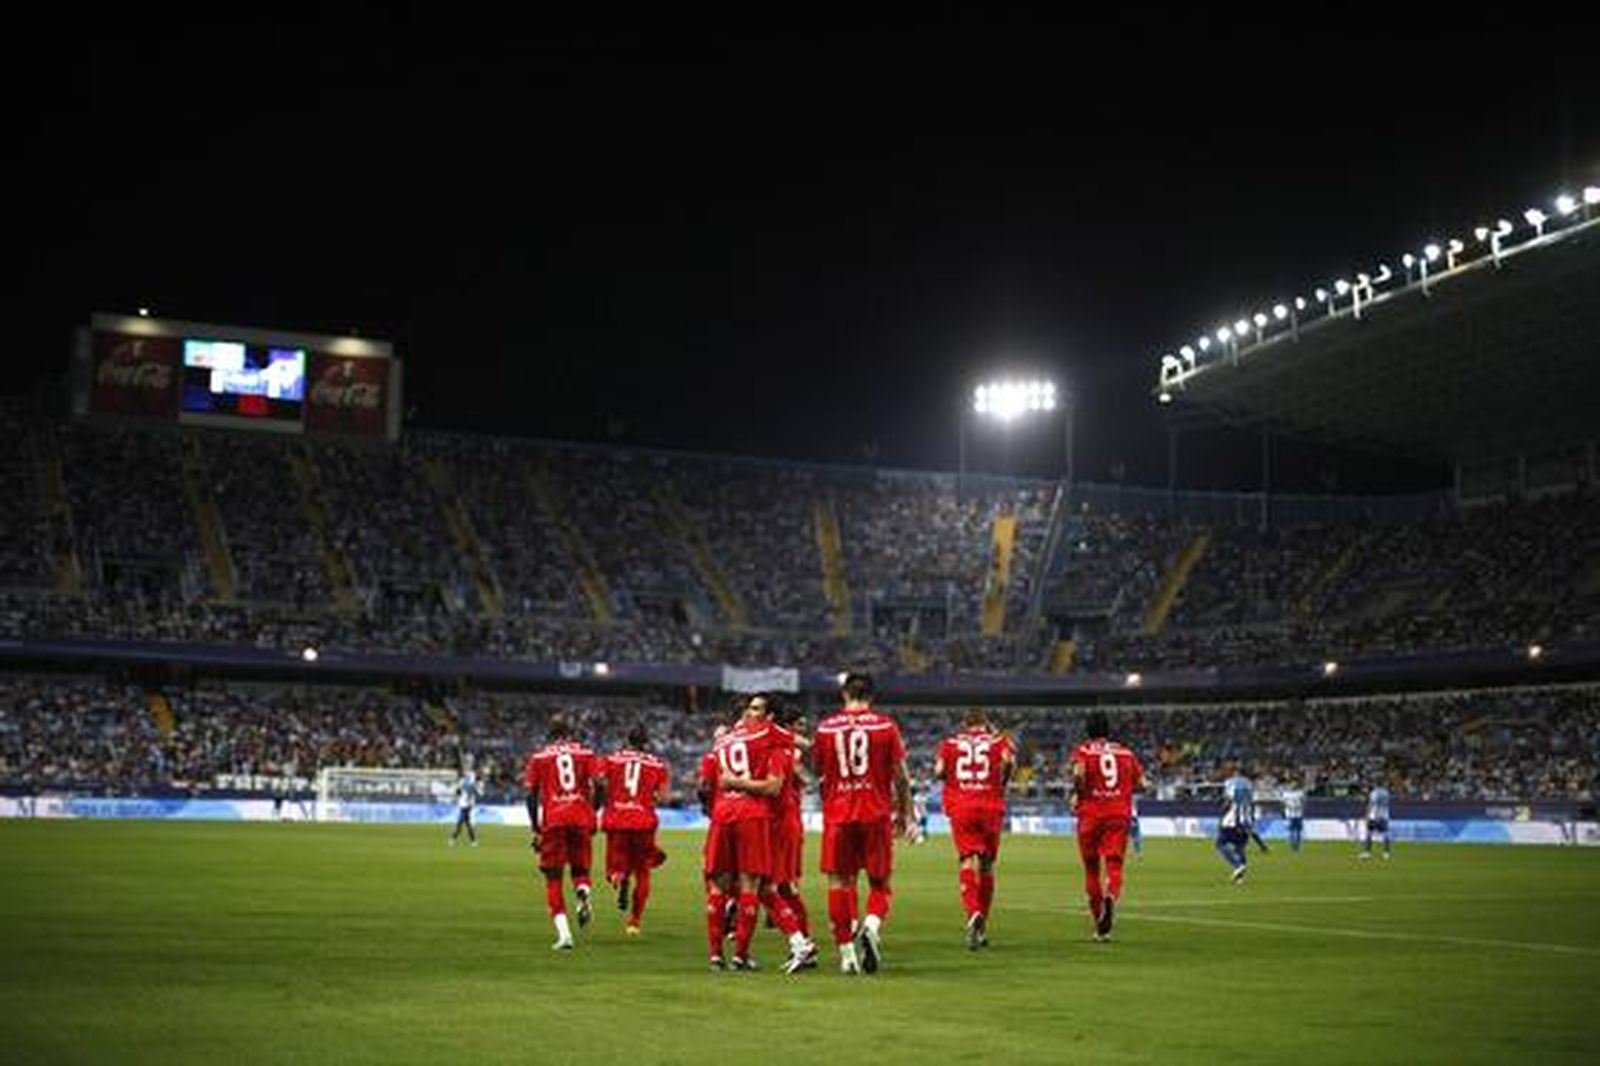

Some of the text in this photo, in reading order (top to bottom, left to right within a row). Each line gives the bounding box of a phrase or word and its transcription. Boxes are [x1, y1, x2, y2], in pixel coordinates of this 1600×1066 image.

[556, 753, 576, 791] 8
[718, 741, 751, 779] 19
[834, 728, 869, 779] 18
[956, 741, 990, 780] 25
[1098, 753, 1118, 788] 9
[624, 761, 642, 798] 4
